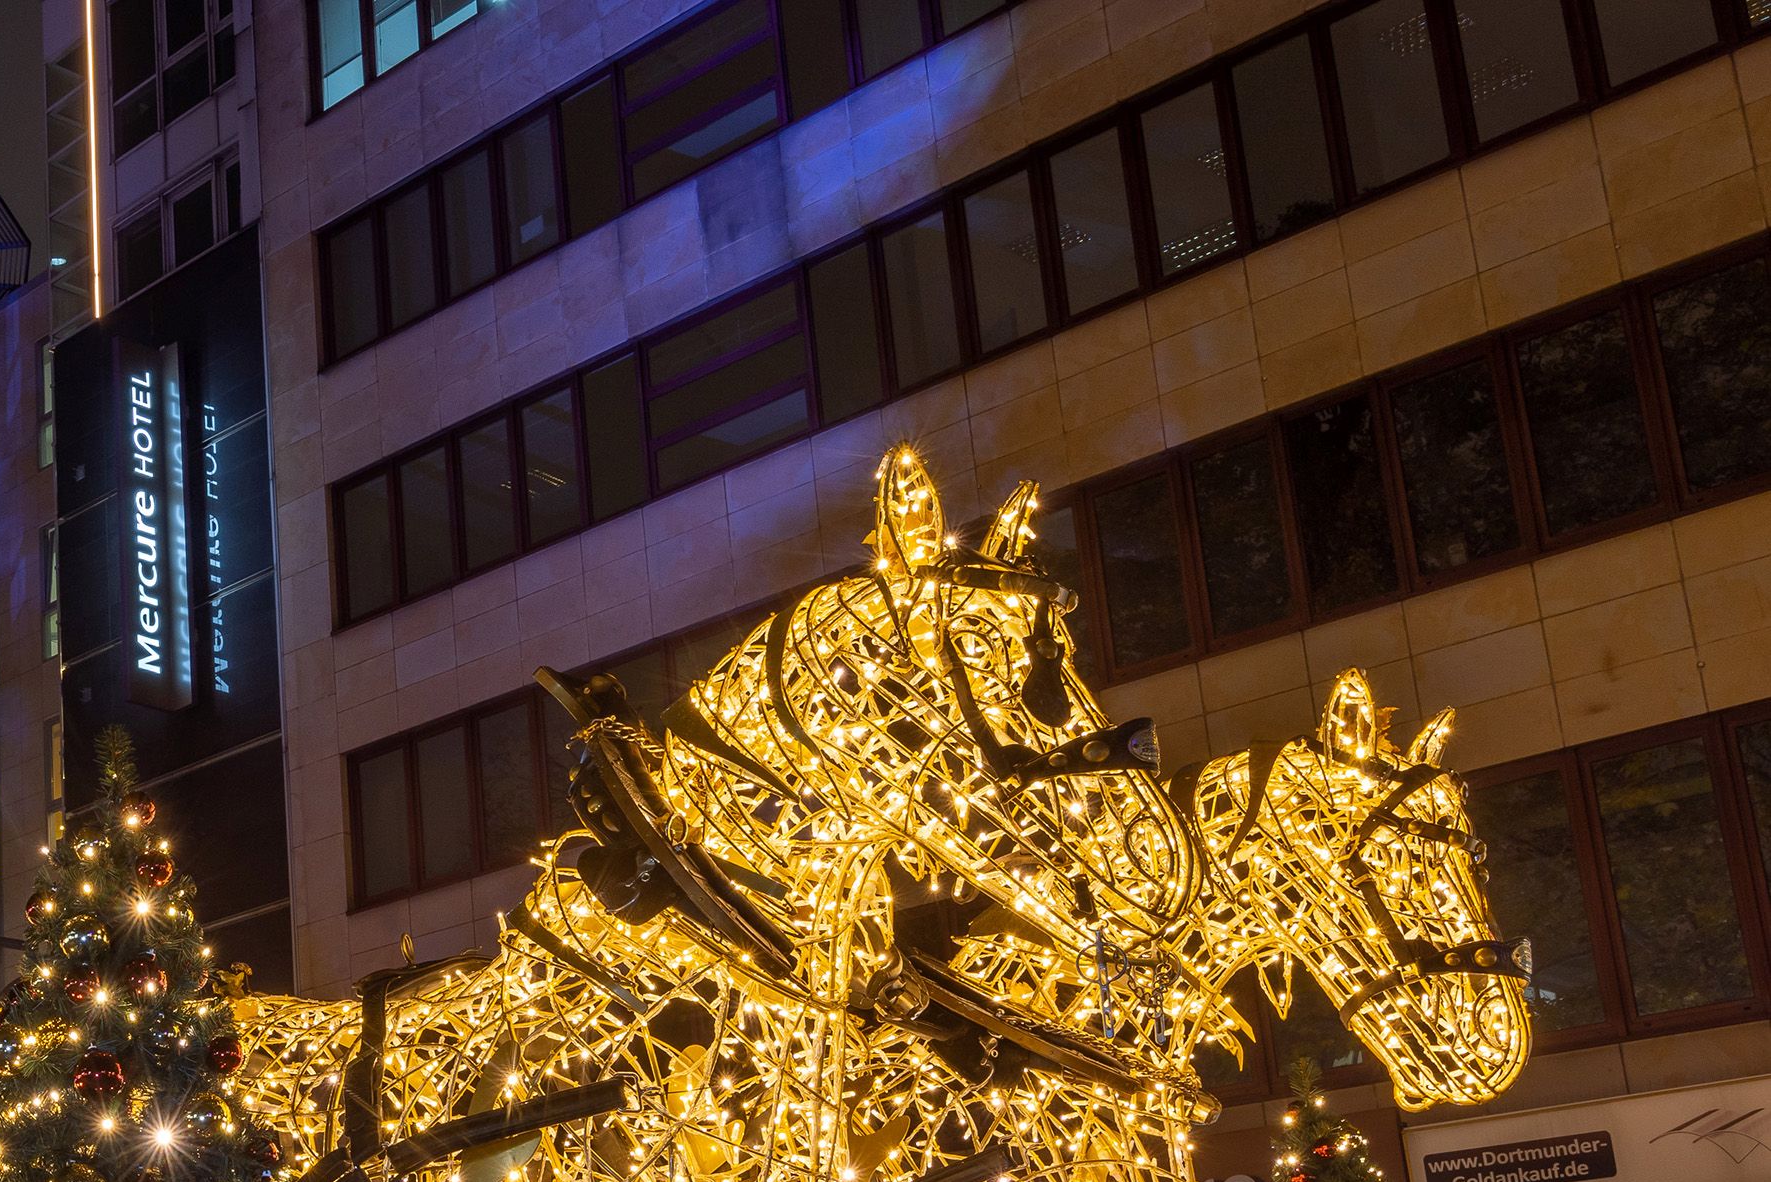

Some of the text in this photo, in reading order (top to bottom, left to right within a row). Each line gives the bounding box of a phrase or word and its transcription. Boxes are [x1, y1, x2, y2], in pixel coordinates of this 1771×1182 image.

[131, 371, 161, 674] Mercure HOTEL
[1428, 1139, 1608, 1173] www.Dortmunder-
